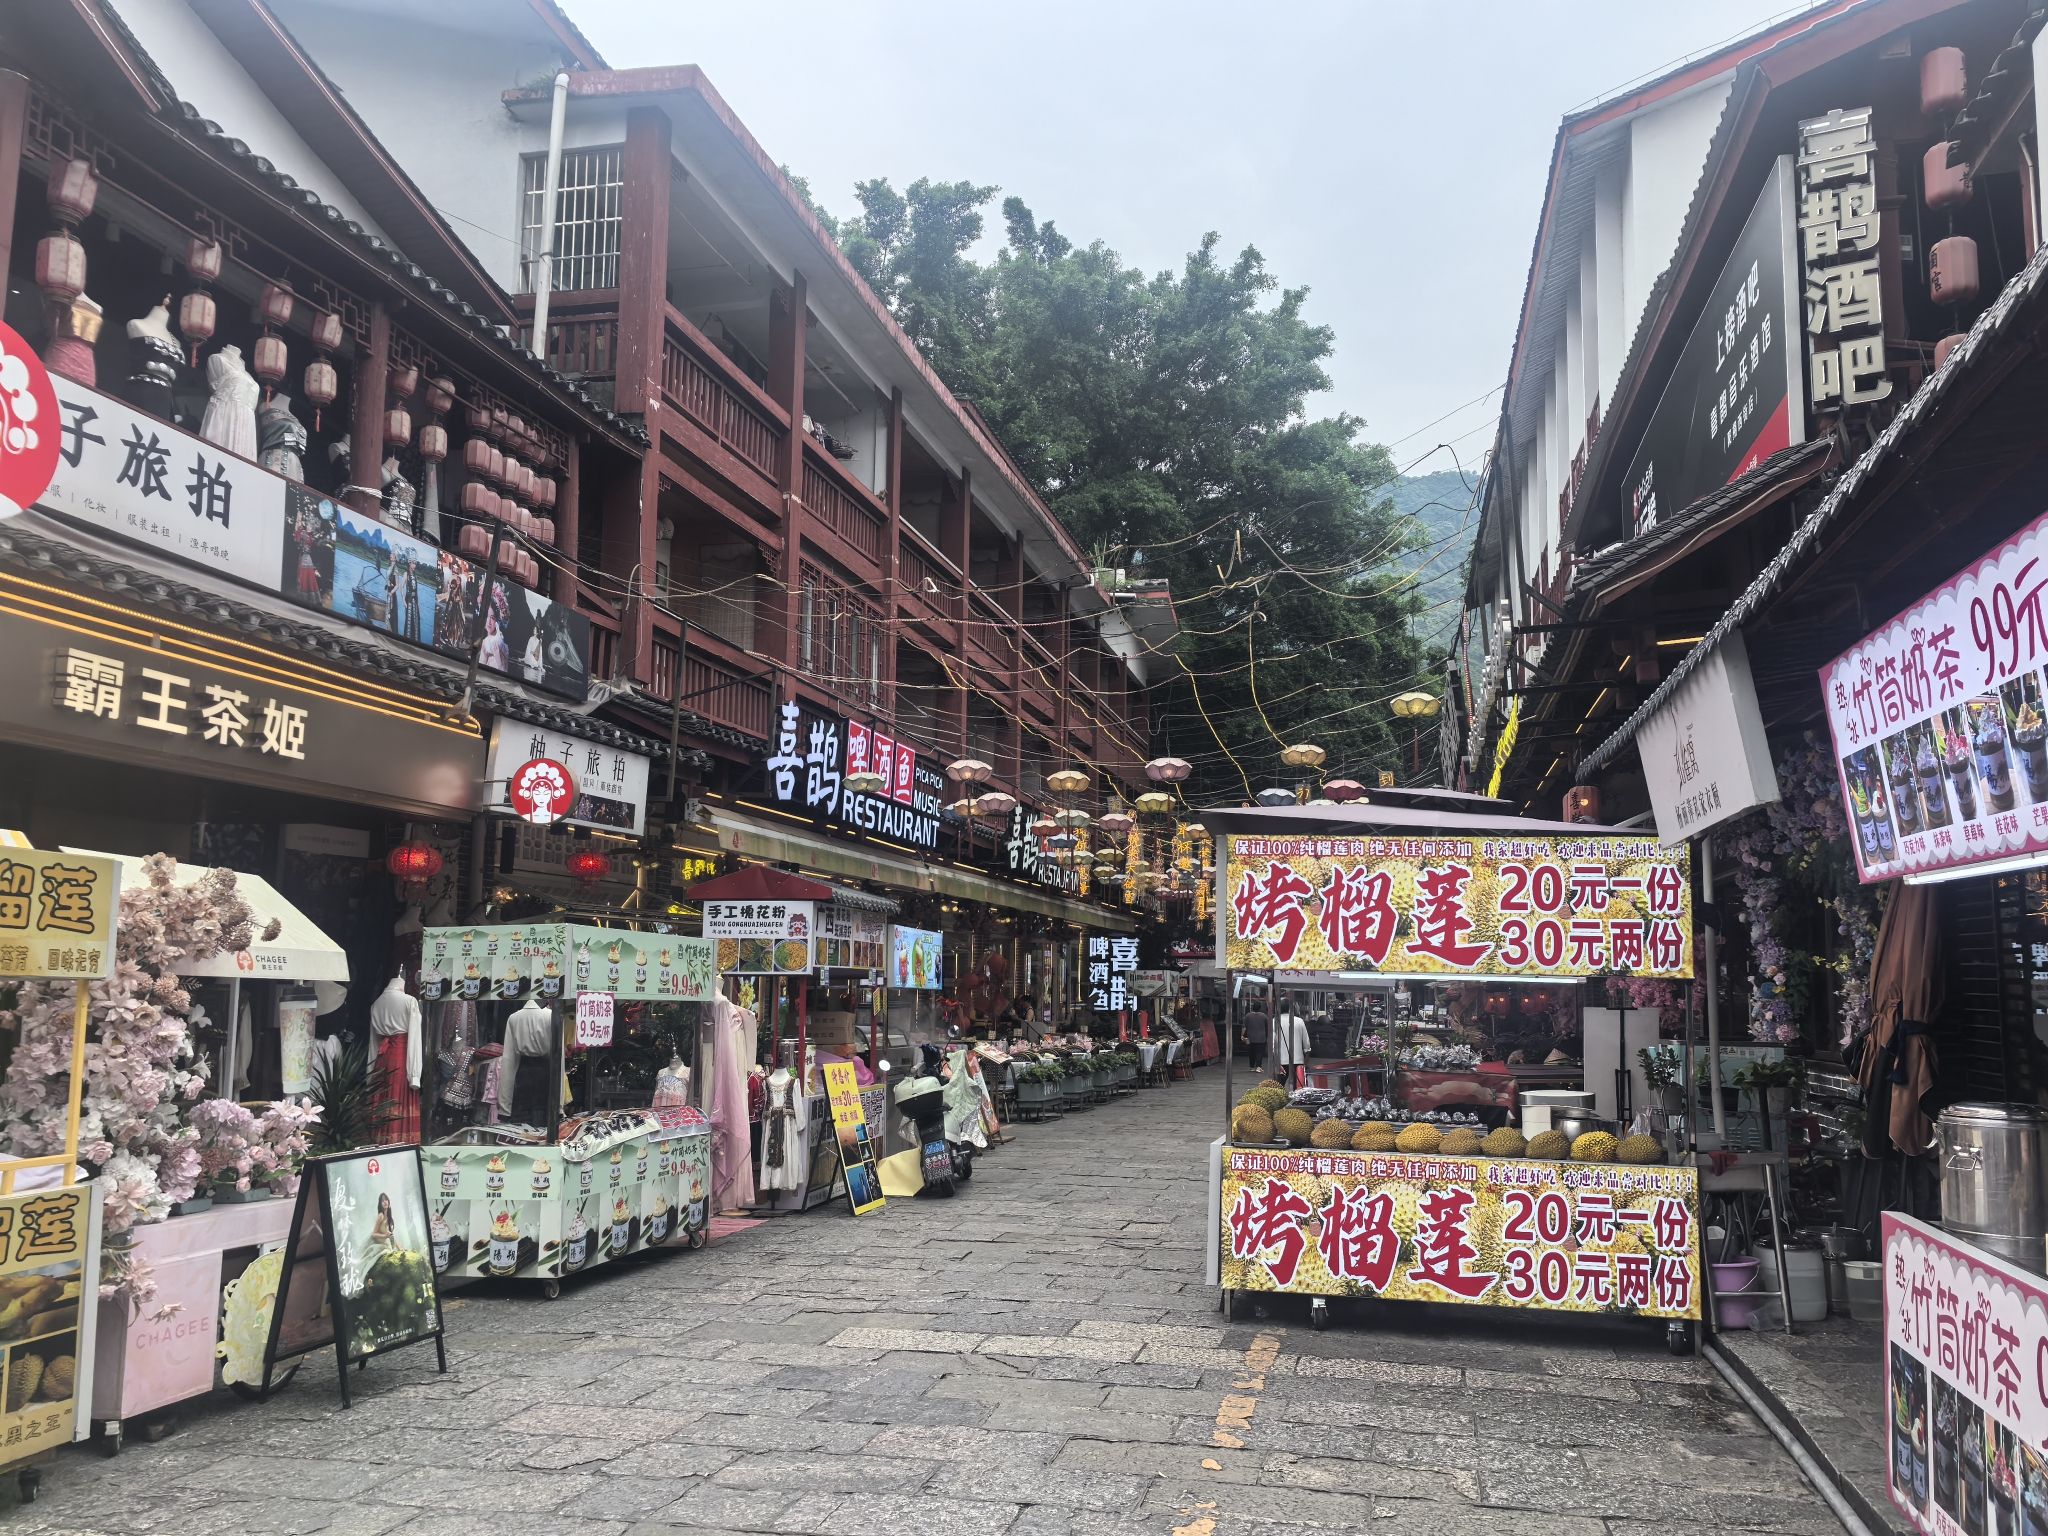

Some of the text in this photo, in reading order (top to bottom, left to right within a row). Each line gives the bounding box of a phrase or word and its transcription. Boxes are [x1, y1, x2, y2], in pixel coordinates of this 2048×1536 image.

[1798, 107, 1893, 405] 喜鹊酒吧
[127, 512, 171, 538] 服装出租
[64, 647, 309, 761] 霸王茶姬
[1852, 623, 1964, 738] 竹筒奶茶
[529, 733, 626, 783] 柚子旅拍
[766, 700, 841, 816] 喜鹊
[915, 767, 943, 792] PICA PICA
[842, 788, 940, 849] RESTAURANT
[913, 789, 941, 818] MUSIC
[1963, 821, 1986, 843] 草莓味
[1995, 813, 2019, 836] 桂花味
[1234, 839, 1365, 857] 保证100%纯榴莲肉
[1369, 839, 1473, 858] 绝无任何添加
[1483, 841, 1551, 859] 我家超好吃
[707, 904, 787, 919] 手工槐花粉
[1500, 864, 1682, 912] 20元一份
[1234, 861, 1494, 967] 烤榴莲
[255, 954, 288, 964] CHAGEE
[1500, 919, 1684, 969] 30元两份
[1088, 936, 1140, 1012] 喜鹊 啤酒鱼
[579, 999, 612, 1018] 竹筒奶茶
[1230, 1153, 1367, 1176] 保证100%纯榴莲肉
[1371, 1159, 1477, 1181] 绝无任何添加
[1488, 1166, 1556, 1186] 我家超好吃
[1230, 1178, 1498, 1297] 烤榴莲
[1504, 1192, 1690, 1249] 20元一份
[1505, 1249, 1691, 1309] 30元两份
[135, 1316, 210, 1351] CHAGEE
[1911, 1273, 2022, 1423] 竹筒奶茶
